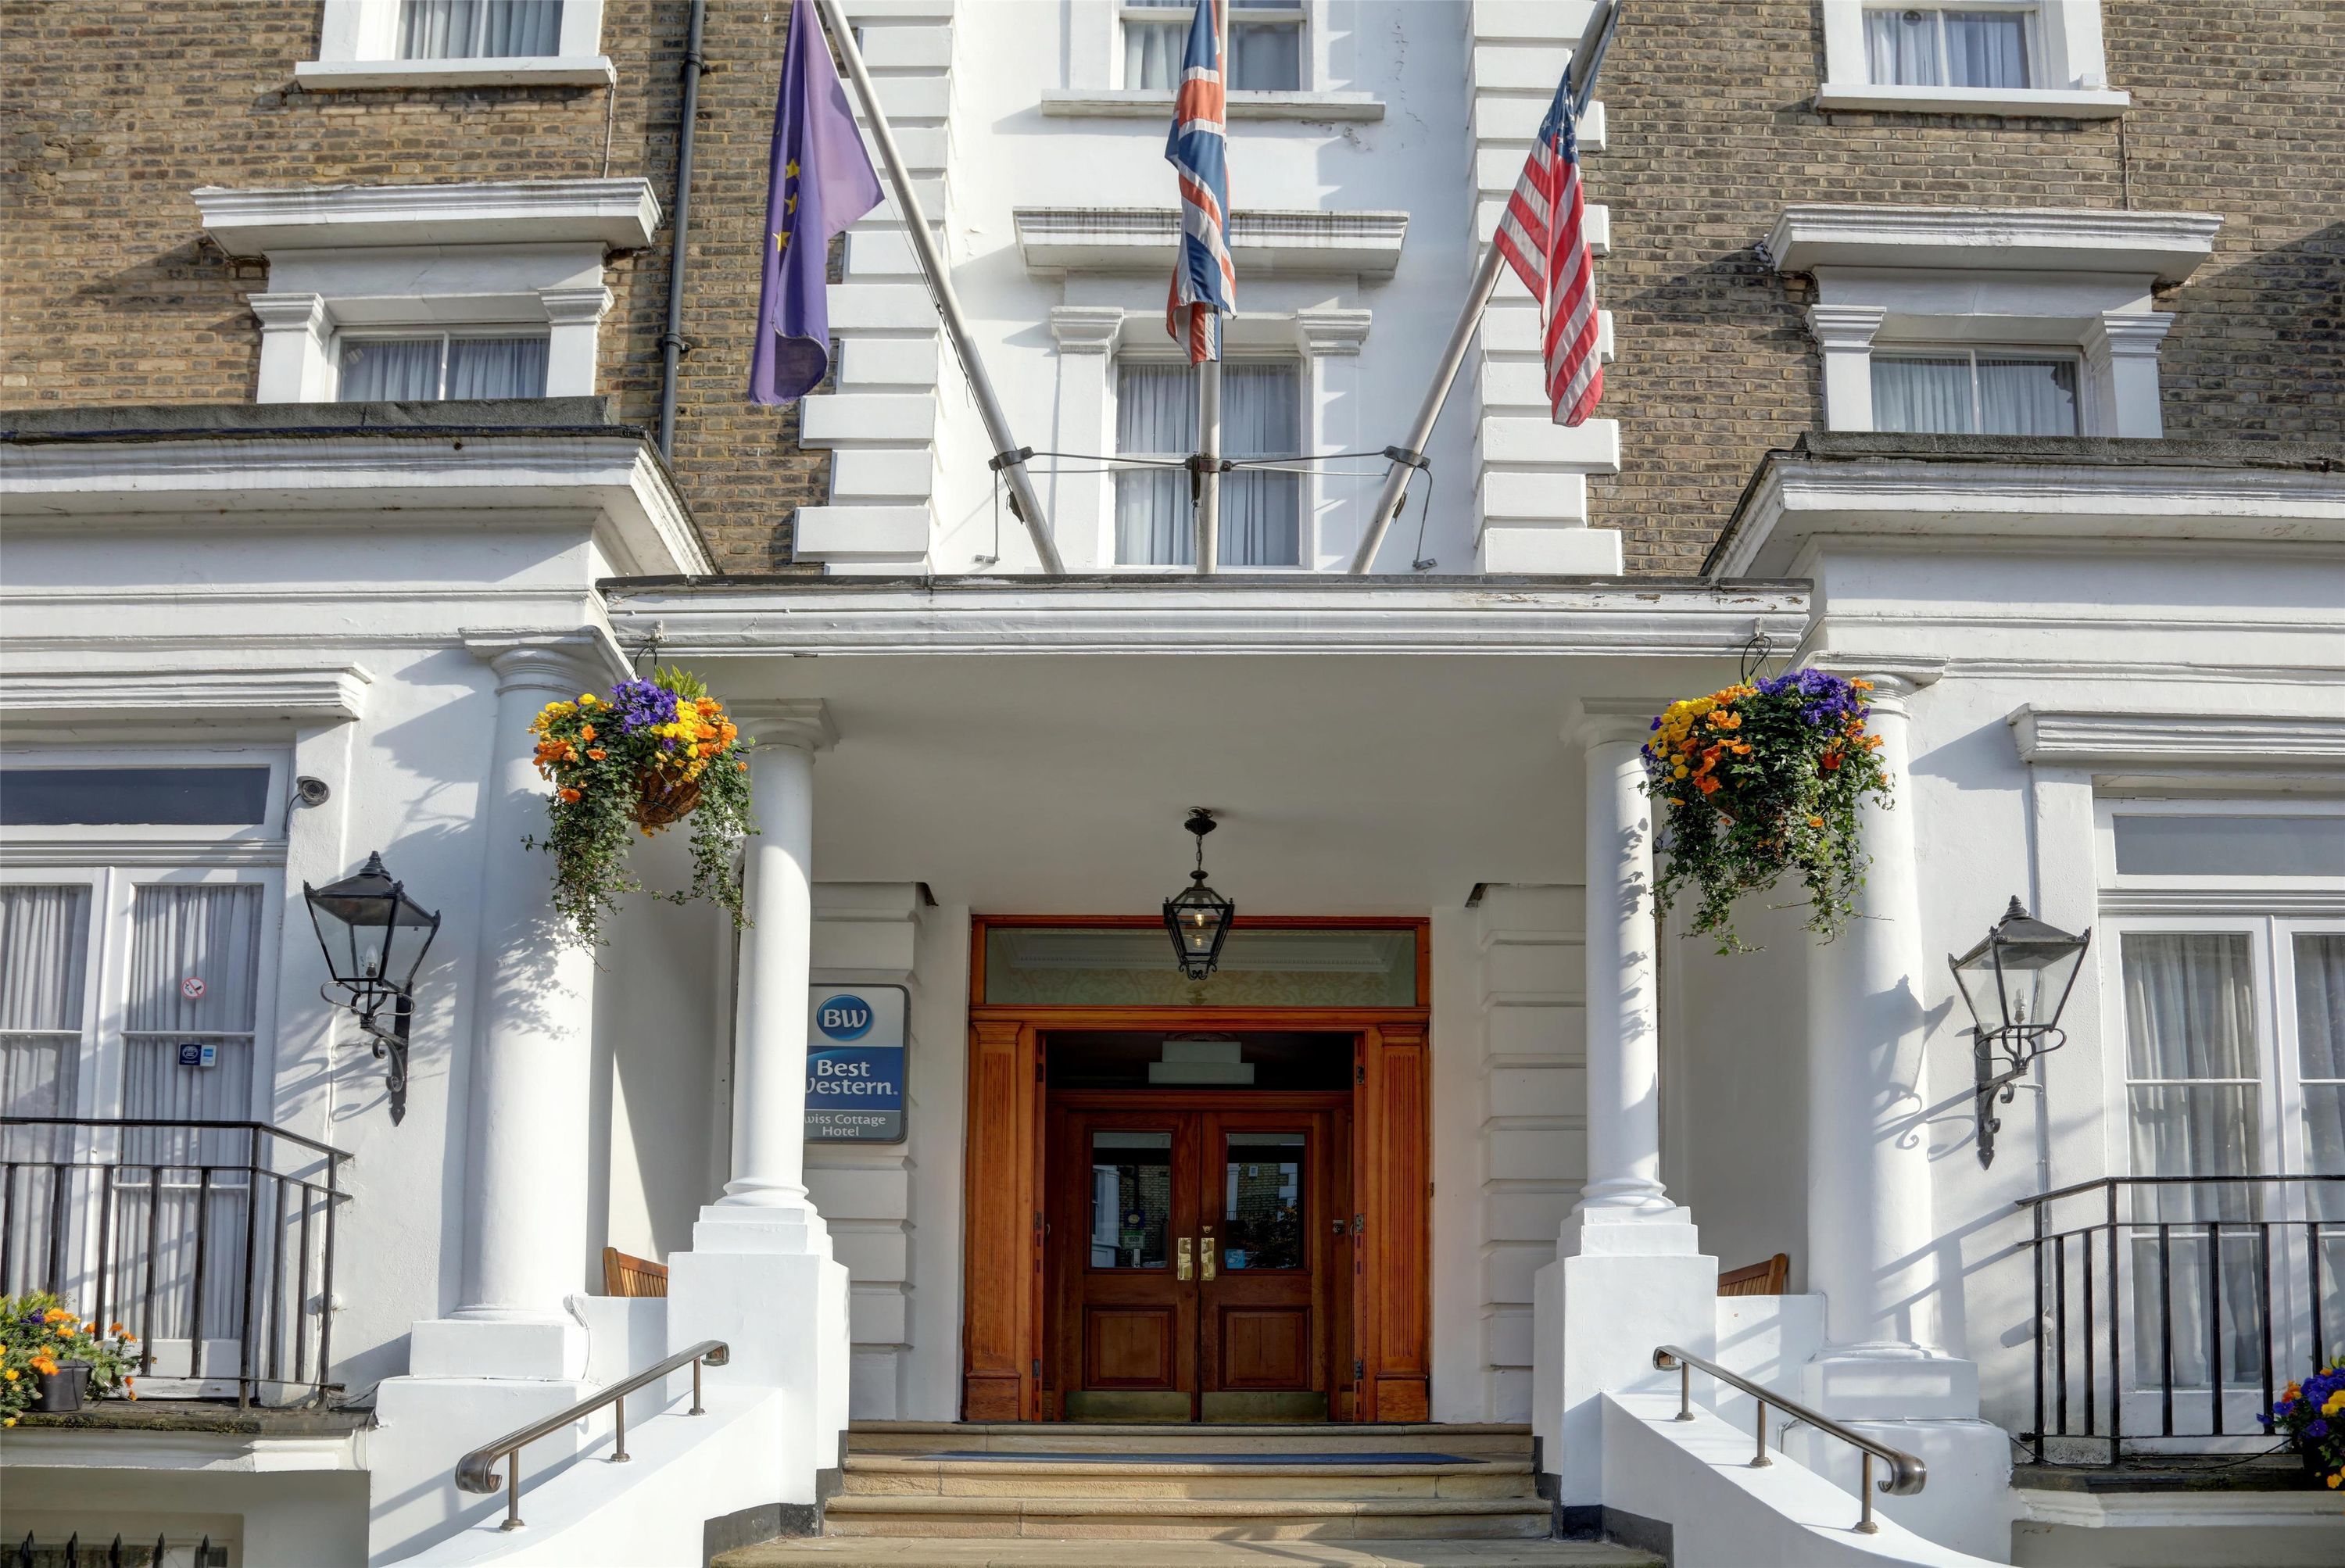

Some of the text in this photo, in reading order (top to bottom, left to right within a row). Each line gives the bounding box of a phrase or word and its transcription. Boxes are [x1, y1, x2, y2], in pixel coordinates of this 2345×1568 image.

[823, 1008, 868, 1028] BW
[817, 1059, 871, 1077] Best
[805, 1113, 886, 1127] wiss Cottage
[822, 1126, 859, 1137] Hotel
